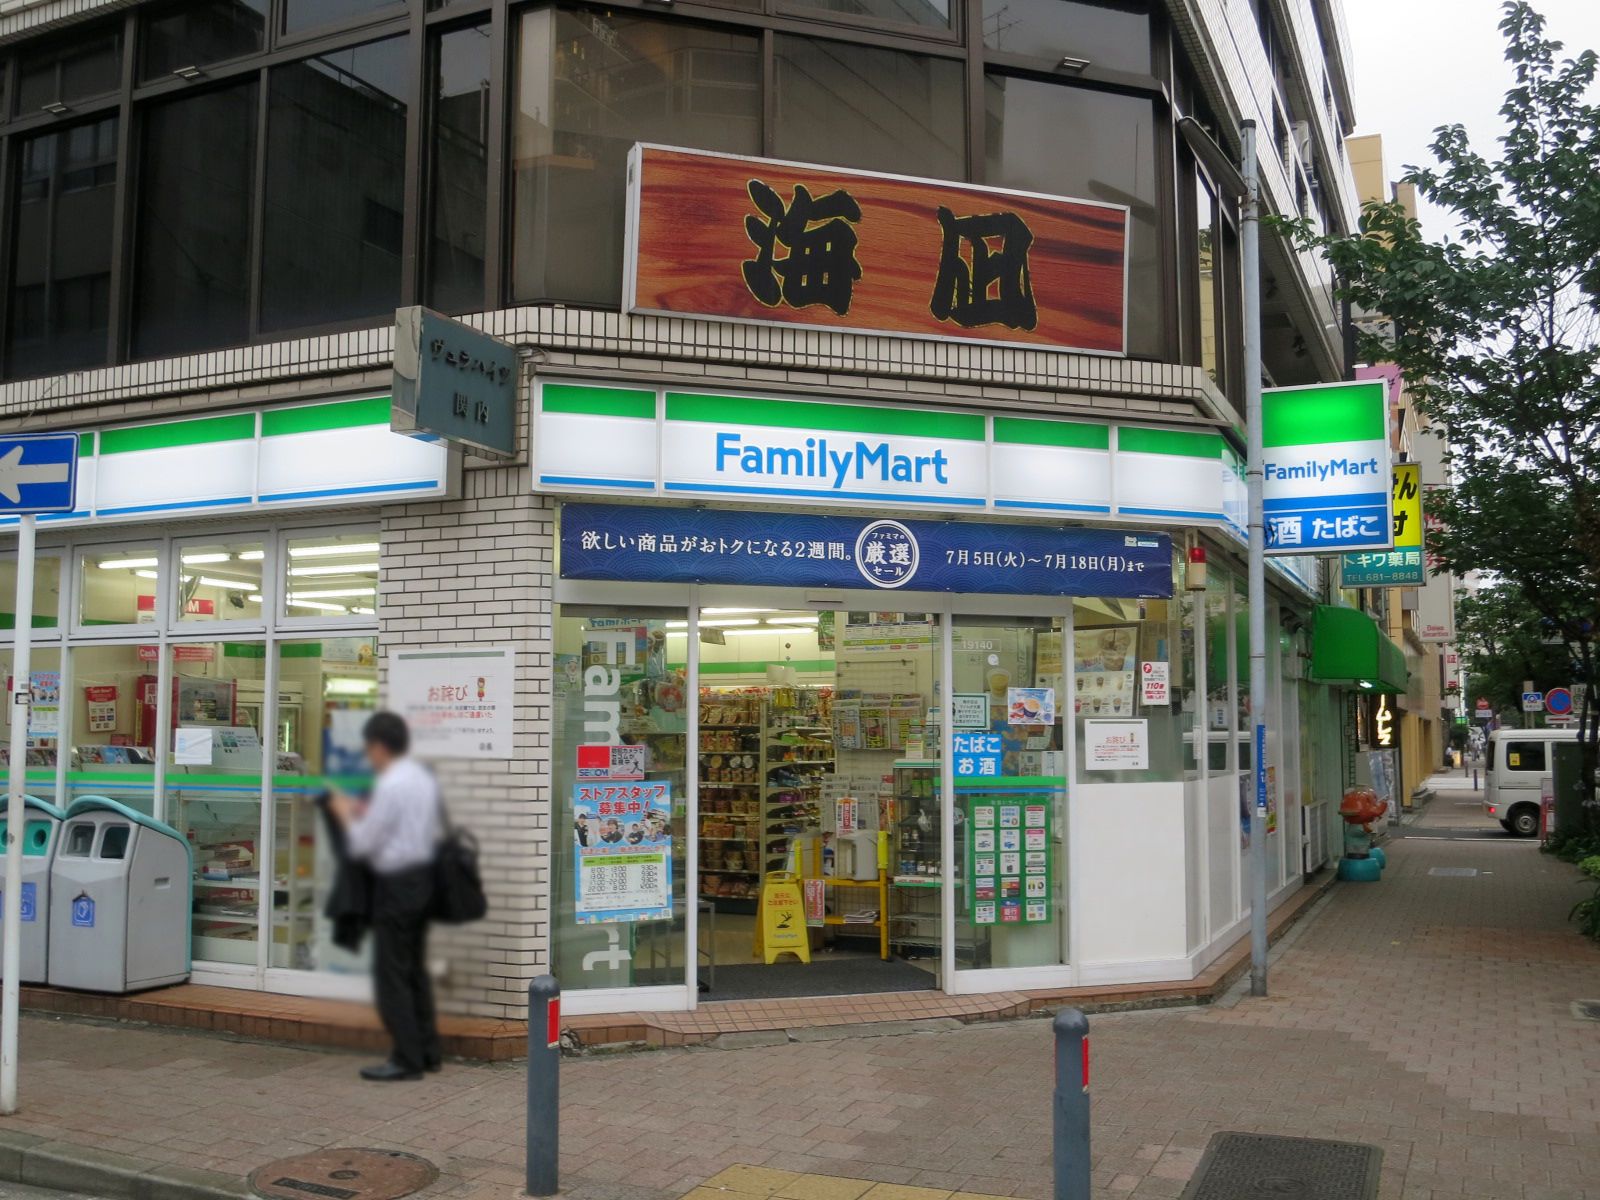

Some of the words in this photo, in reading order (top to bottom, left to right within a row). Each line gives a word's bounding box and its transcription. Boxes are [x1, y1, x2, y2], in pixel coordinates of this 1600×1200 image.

[716, 432, 949, 489] FamilyMart
[1264, 458, 1378, 481] FamilyMart
[1268, 516, 1303, 545] 酒
[1312, 515, 1380, 540] たばこ
[864, 541, 912, 566] 厳選
[1343, 551, 1421, 568] トキワ薬局
[872, 565, 905, 577] セール
[1346, 574, 1362, 582] TEL
[954, 736, 1000, 753] たばこ
[579, 768, 609, 777] SECOM
[958, 757, 996, 776] お酒
[579, 785, 666, 801] ストアスタッフ
